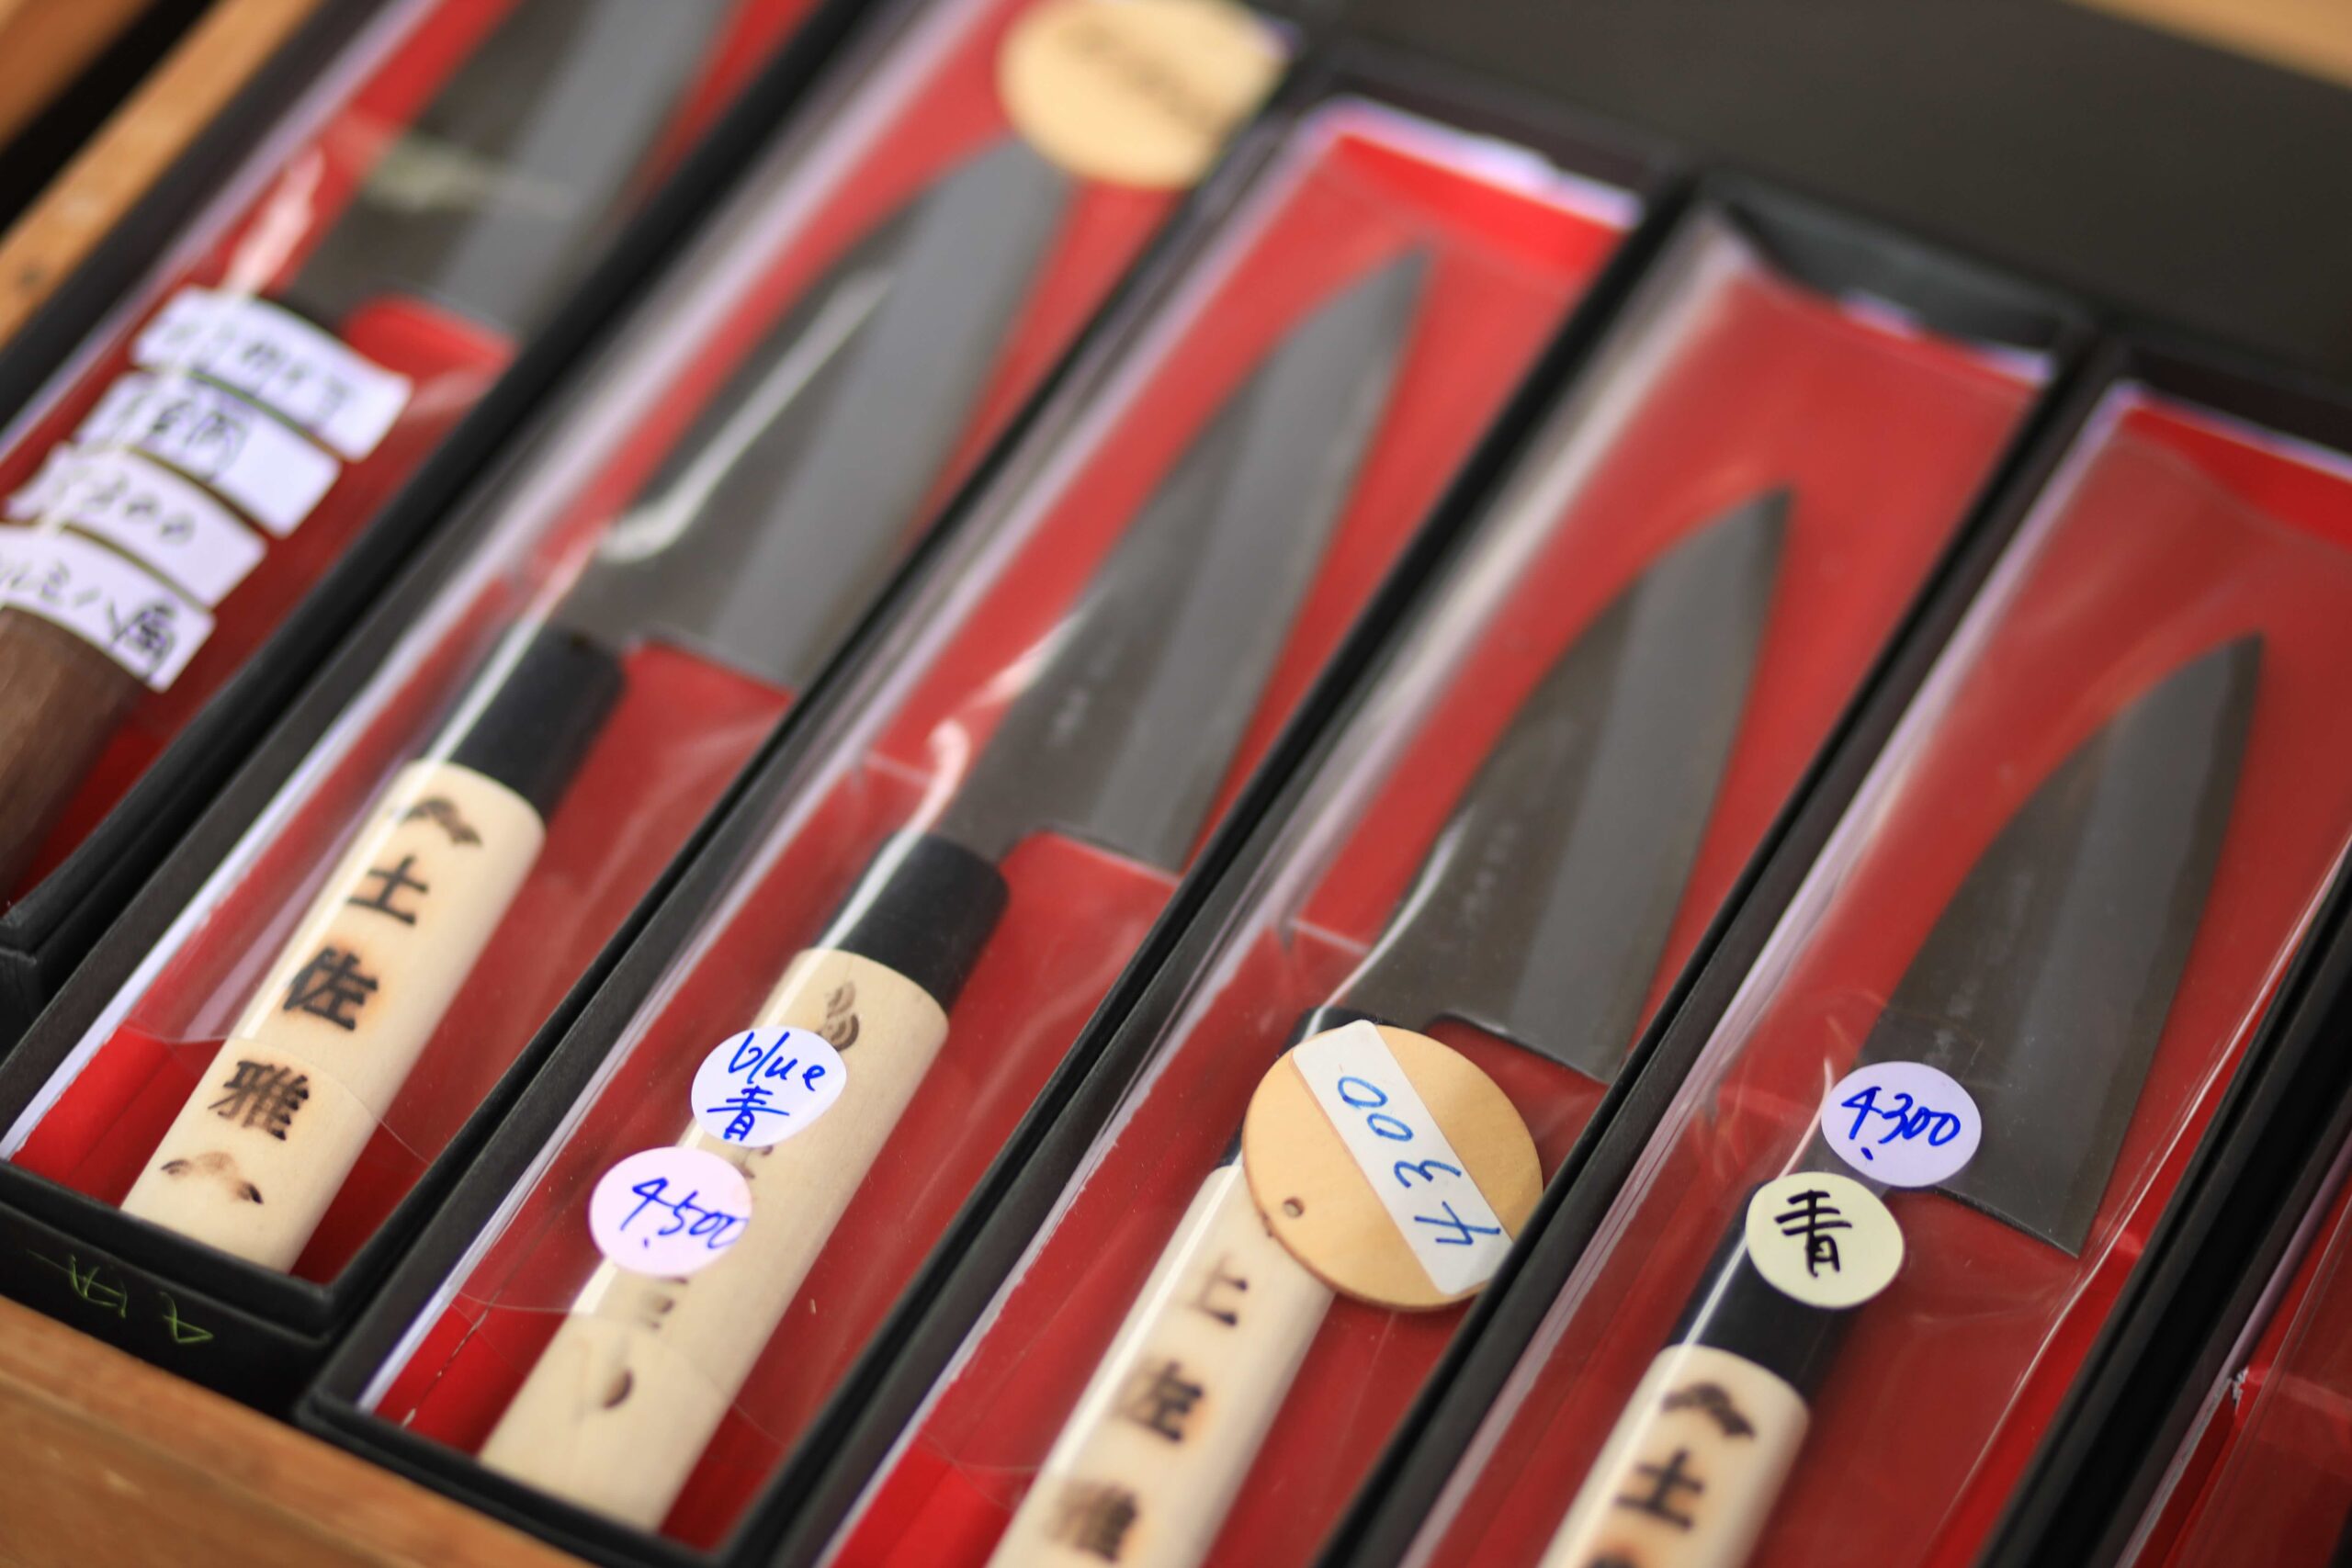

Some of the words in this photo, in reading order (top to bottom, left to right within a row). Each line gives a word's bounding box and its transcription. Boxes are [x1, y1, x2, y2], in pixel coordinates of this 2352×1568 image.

[208, 854, 429, 1141] 土佐雅
[728, 1031, 827, 1092] blue
[707, 1085, 791, 1142] 青
[1773, 1188, 1853, 1279] 青
